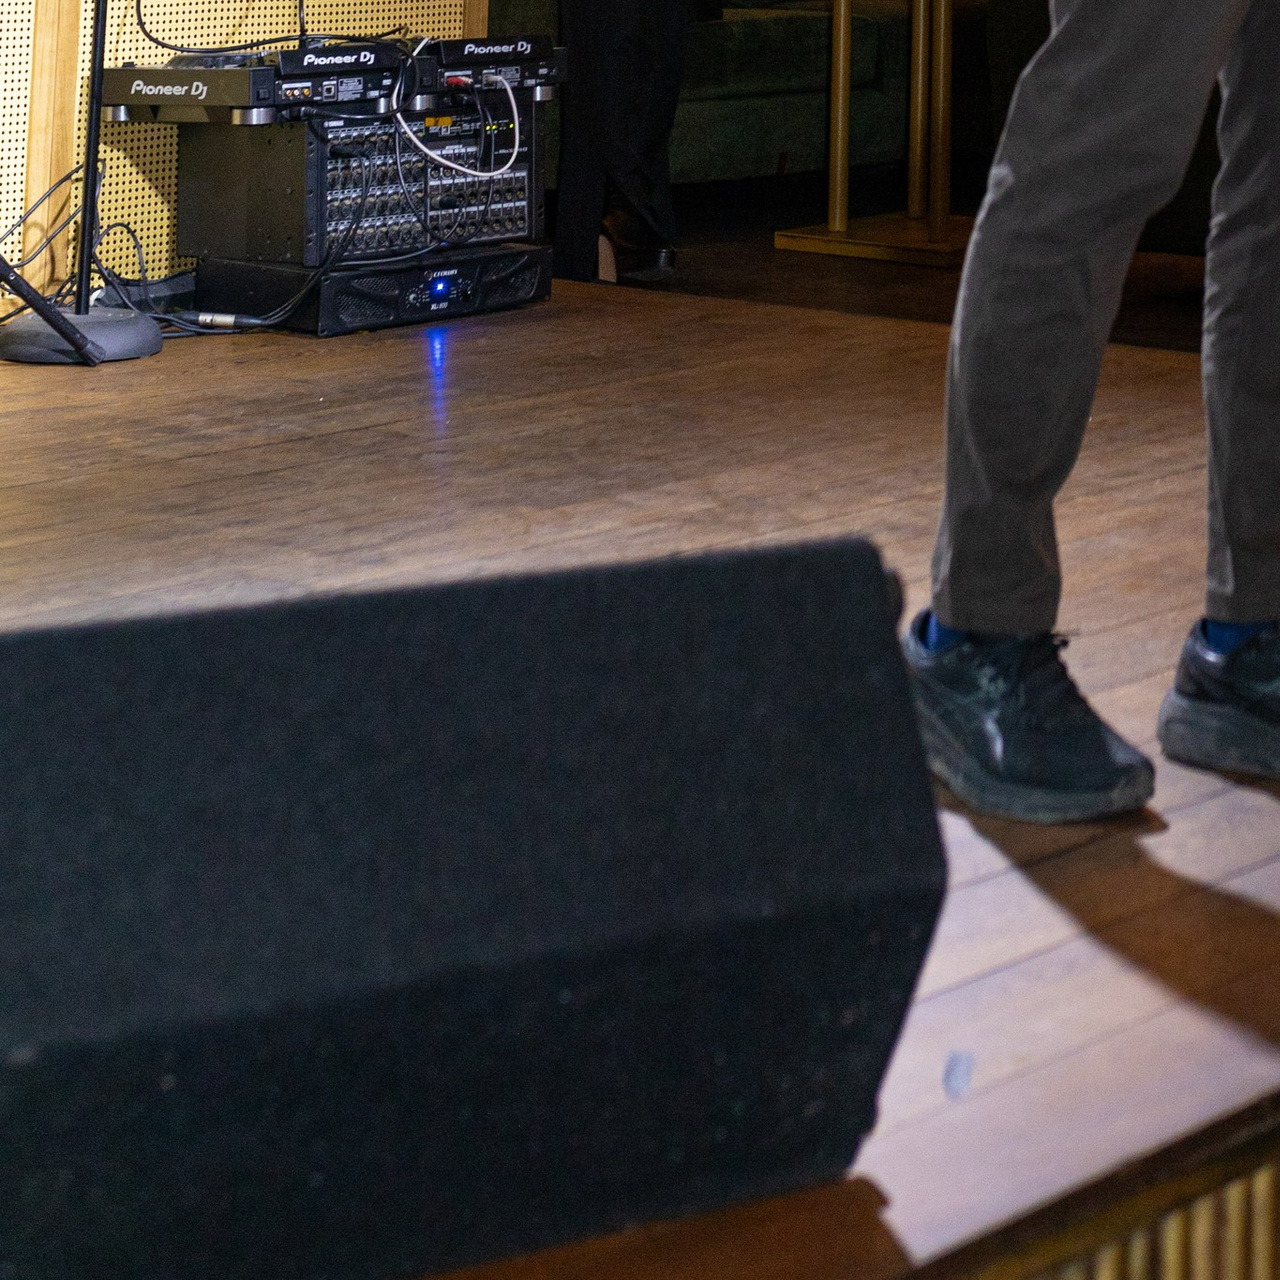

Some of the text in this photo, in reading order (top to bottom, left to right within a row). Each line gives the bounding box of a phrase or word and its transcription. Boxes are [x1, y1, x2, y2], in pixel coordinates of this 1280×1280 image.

[464, 43, 515, 55] Pioneer
[303, 53, 358, 66] Pioneer
[131, 80, 188, 96] Pioneer
